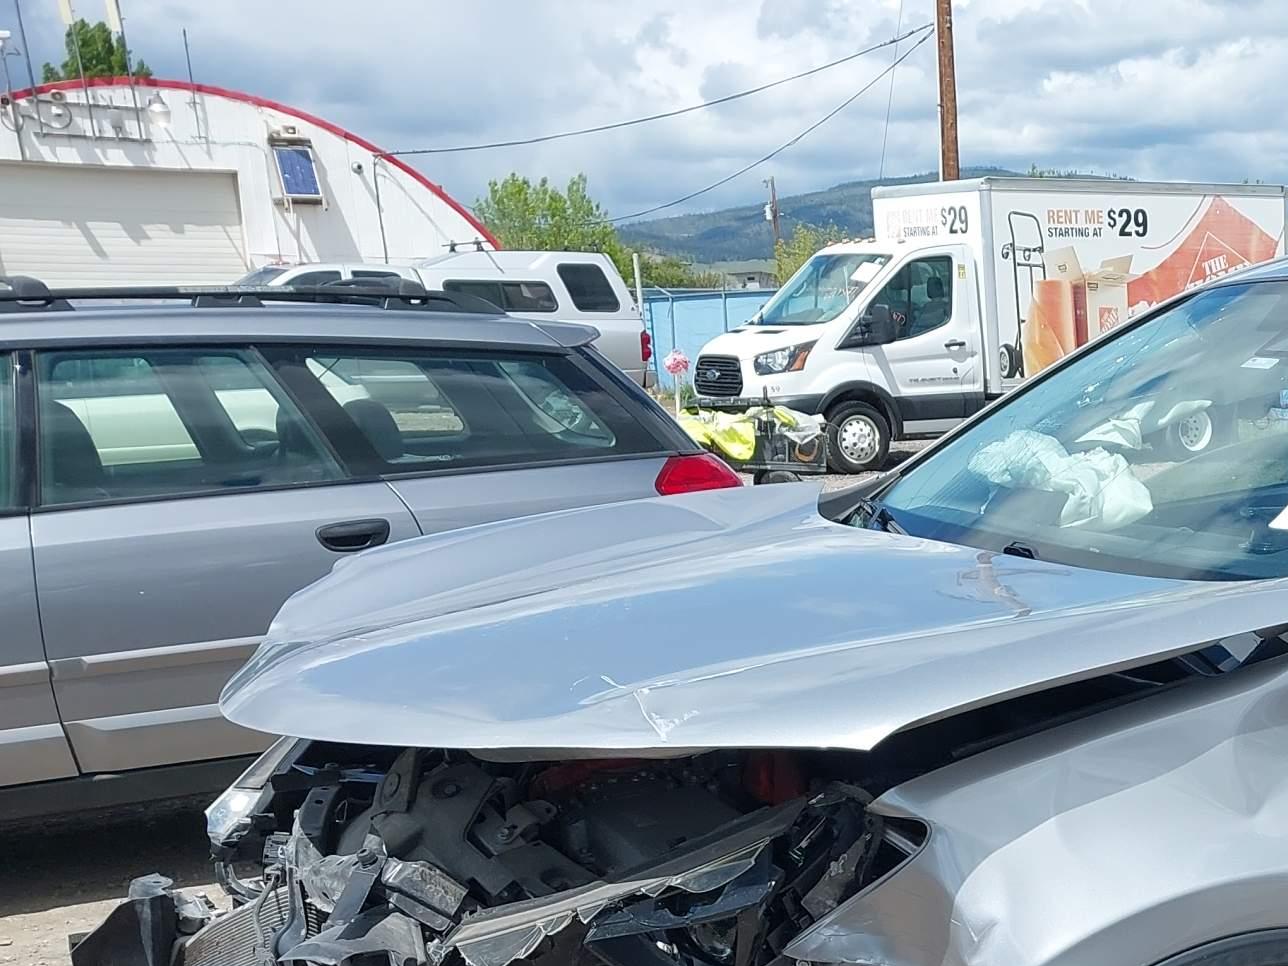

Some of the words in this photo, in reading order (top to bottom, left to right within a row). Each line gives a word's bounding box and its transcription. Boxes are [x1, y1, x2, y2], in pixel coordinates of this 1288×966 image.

[940, 205, 968, 234] $29
[1047, 209, 1080, 224] RENT
[1085, 209, 1104, 224] ME
[1107, 207, 1148, 237] $29
[1047, 227, 1090, 238] STARTING
[1092, 227, 1103, 238] AT
[1202, 254, 1228, 275] THE
